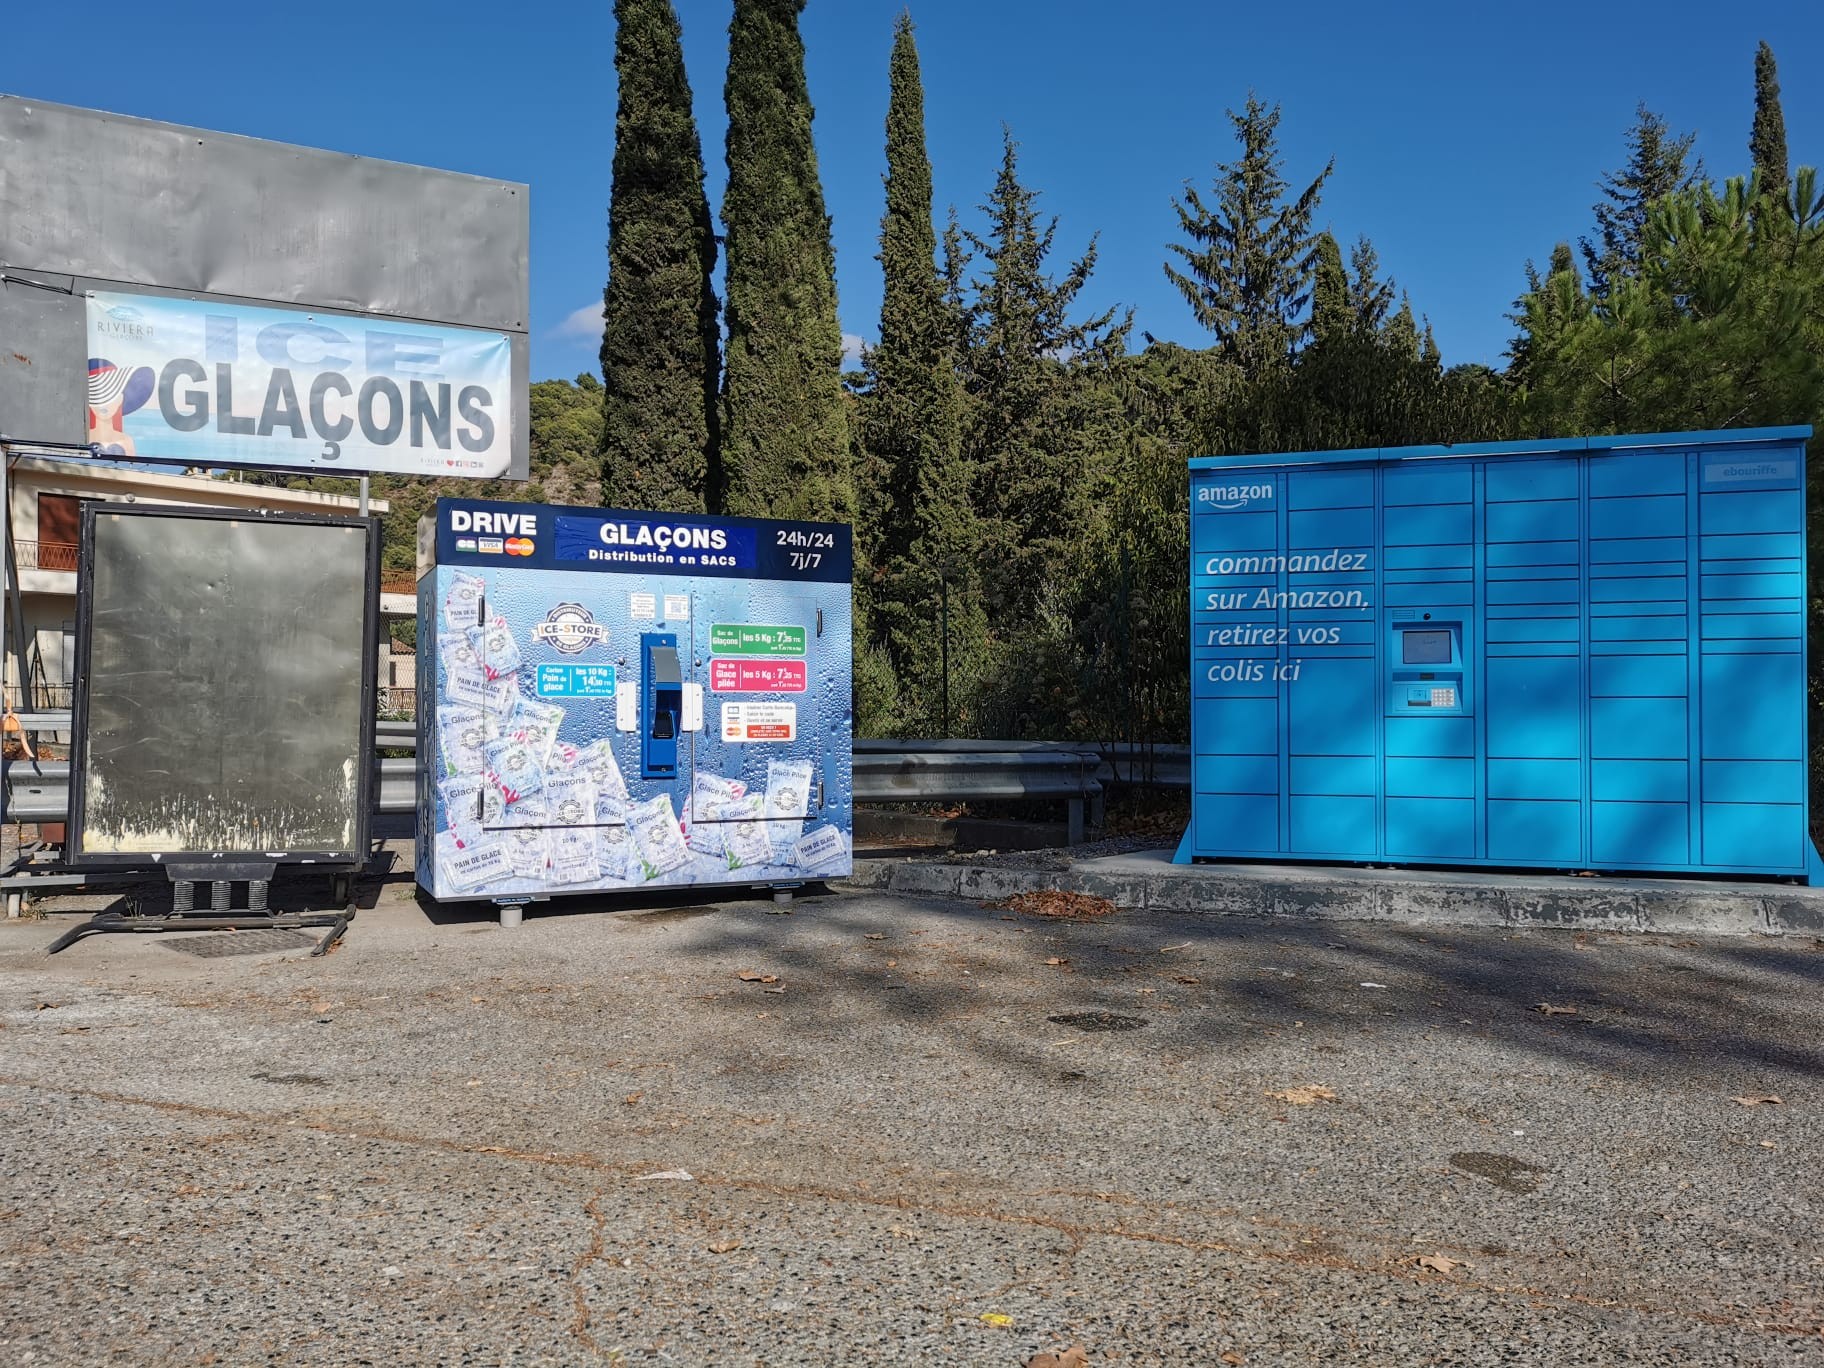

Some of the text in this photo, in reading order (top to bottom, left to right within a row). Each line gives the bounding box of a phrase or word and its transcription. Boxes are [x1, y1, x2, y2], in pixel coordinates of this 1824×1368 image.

[97, 321, 154, 337] RIVIERA
[205, 314, 445, 381] ICE
[158, 358, 495, 460] GLAÇONS
[1723, 465, 1777, 477] ebouriffe
[1198, 484, 1273, 501] amazon
[452, 510, 537, 535] DRIVE
[600, 523, 727, 552] GLAÇONS
[776, 530, 834, 548] 24h/24
[588, 549, 736, 566] Distribution en SACS
[790, 552, 822, 570] 7j/7
[1206, 549, 1367, 575] commandez
[1206, 587, 1369, 612] sur Amazon,
[540, 624, 601, 636] ICE-STORE
[743, 633, 754, 642] les
[755, 634, 761, 642] 5
[761, 633, 772, 643] Kg
[1207, 624, 1341, 646] retirez vos
[712, 637, 739, 646] Glaçons
[542, 673, 559, 682] Pain
[598, 668, 608, 677] Kg
[716, 670, 736, 678] Glace
[743, 670, 754, 678] les
[761, 670, 772, 680] Kg
[1207, 659, 1302, 682] colis ici
[457, 677, 471, 686] PAIN
[481, 683, 500, 693] GLACE
[543, 683, 564, 692] glace
[451, 713, 484, 724] Glaçons
[548, 777, 586, 788] Glaçons
[700, 783, 720, 795] Glace
[636, 809, 665, 824] Glaçons
[801, 845, 813, 853] PAIN
[454, 848, 502, 869] PAIN DE GLACE
